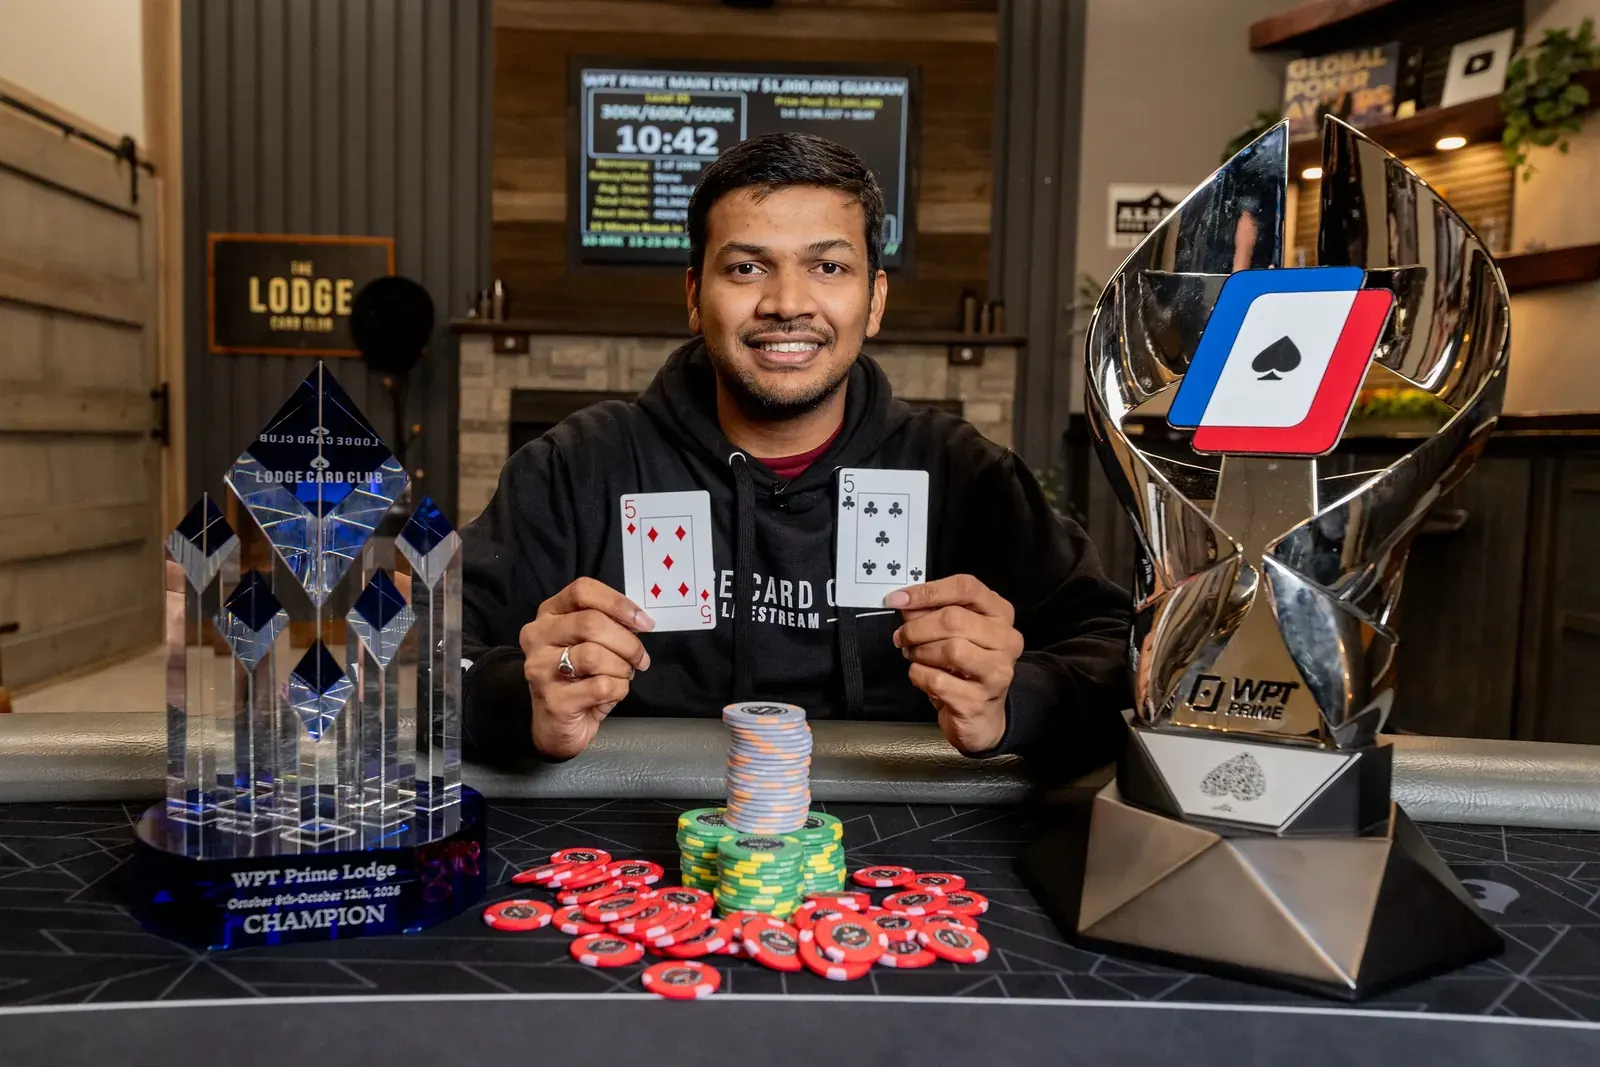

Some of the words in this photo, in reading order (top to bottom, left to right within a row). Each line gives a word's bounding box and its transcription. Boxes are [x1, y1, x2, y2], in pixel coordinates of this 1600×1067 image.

[1287, 47, 1387, 80] GLOBAL
[583, 73, 617, 88] WPT
[619, 74, 666, 89] PRIME
[668, 76, 711, 90] MAIN
[712, 77, 759, 92] EVENT
[1285, 70, 1370, 102] POKER
[616, 124, 719, 155] 10:42
[291, 260, 313, 276] THE
[249, 276, 354, 315] LODGE
[270, 316, 301, 331] CARD
[303, 317, 334, 333] CLUB
[255, 470, 303, 484] LODGE
[306, 470, 343, 484] CARD
[347, 471, 383, 484] CLUB
[843, 474, 855, 493] 5
[624, 499, 637, 519] 5
[700, 604, 712, 624] 5
[1230, 676, 1299, 705] WPT
[1226, 702, 1285, 720] PRIME
[231, 870, 280, 888] WPT
[284, 866, 338, 884] Prime
[342, 861, 397, 881] Lodge
[227, 896, 274, 910] October
[243, 904, 387, 934] CHAMPION
